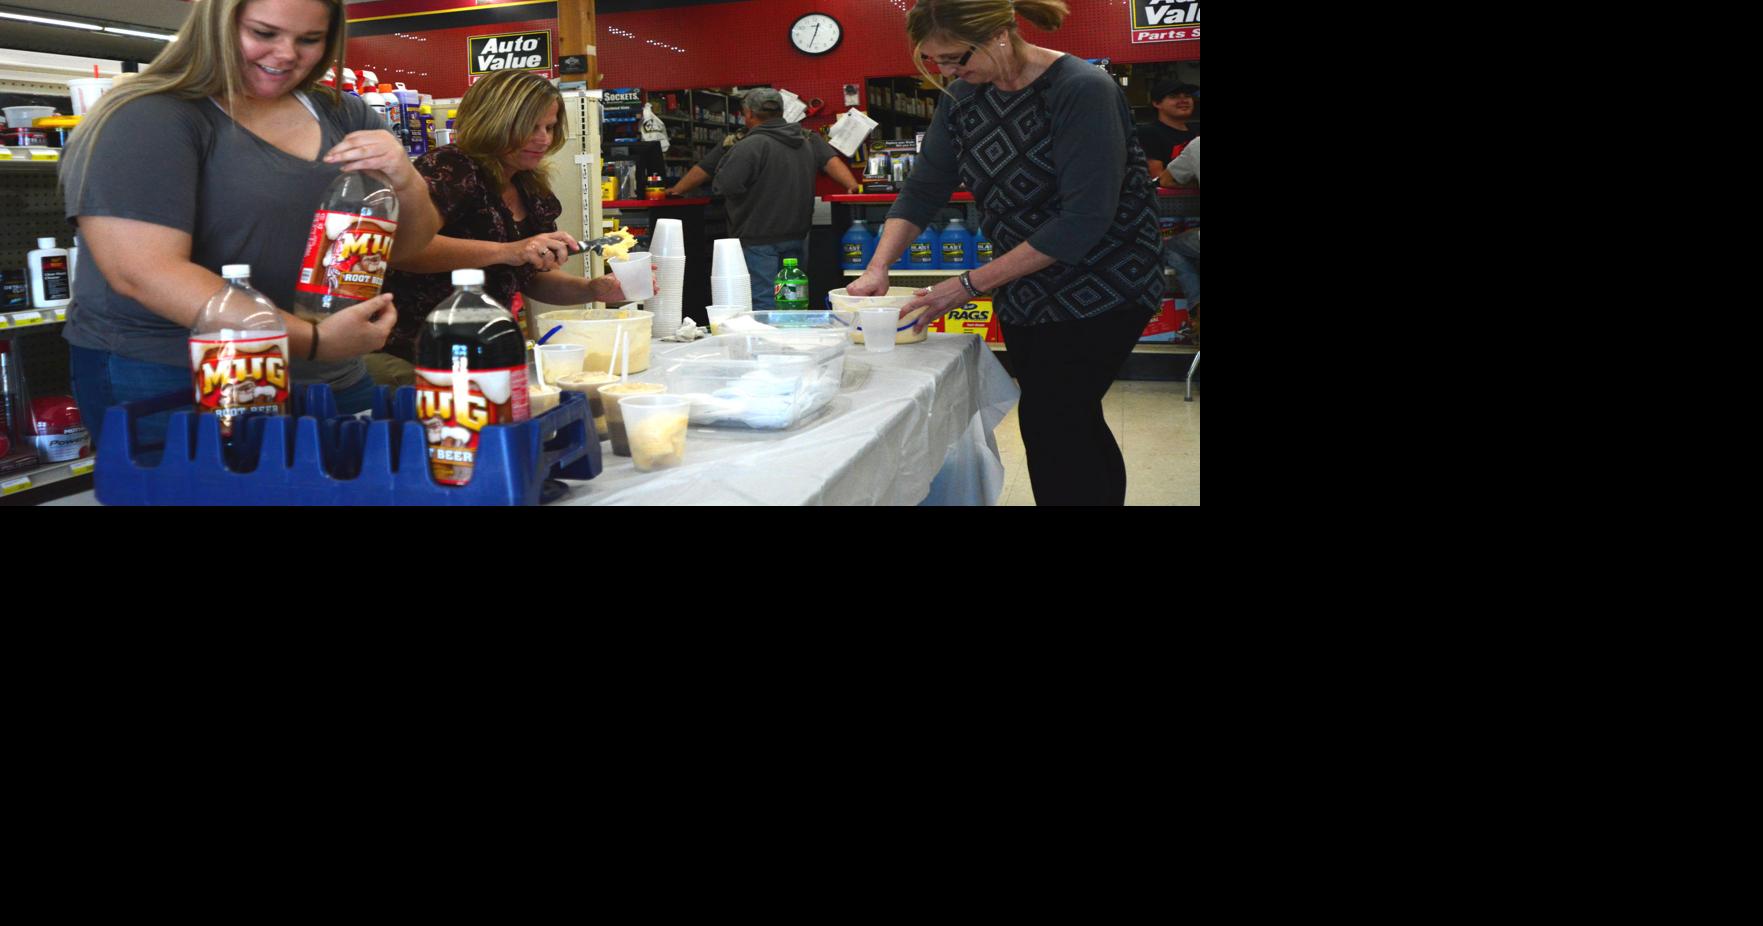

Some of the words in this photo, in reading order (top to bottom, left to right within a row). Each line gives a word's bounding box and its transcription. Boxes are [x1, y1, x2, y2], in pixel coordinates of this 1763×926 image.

[1144, 3, 1200, 25] Val
[1137, 30, 1186, 41] Parts
[481, 36, 539, 54] Auto
[477, 53, 542, 71] Value
[337, 232, 395, 263] MU
[344, 274, 371, 283] ROOT
[948, 310, 990, 320] RAGS
[202, 357, 286, 396] MUG
[437, 448, 473, 463] BEER
